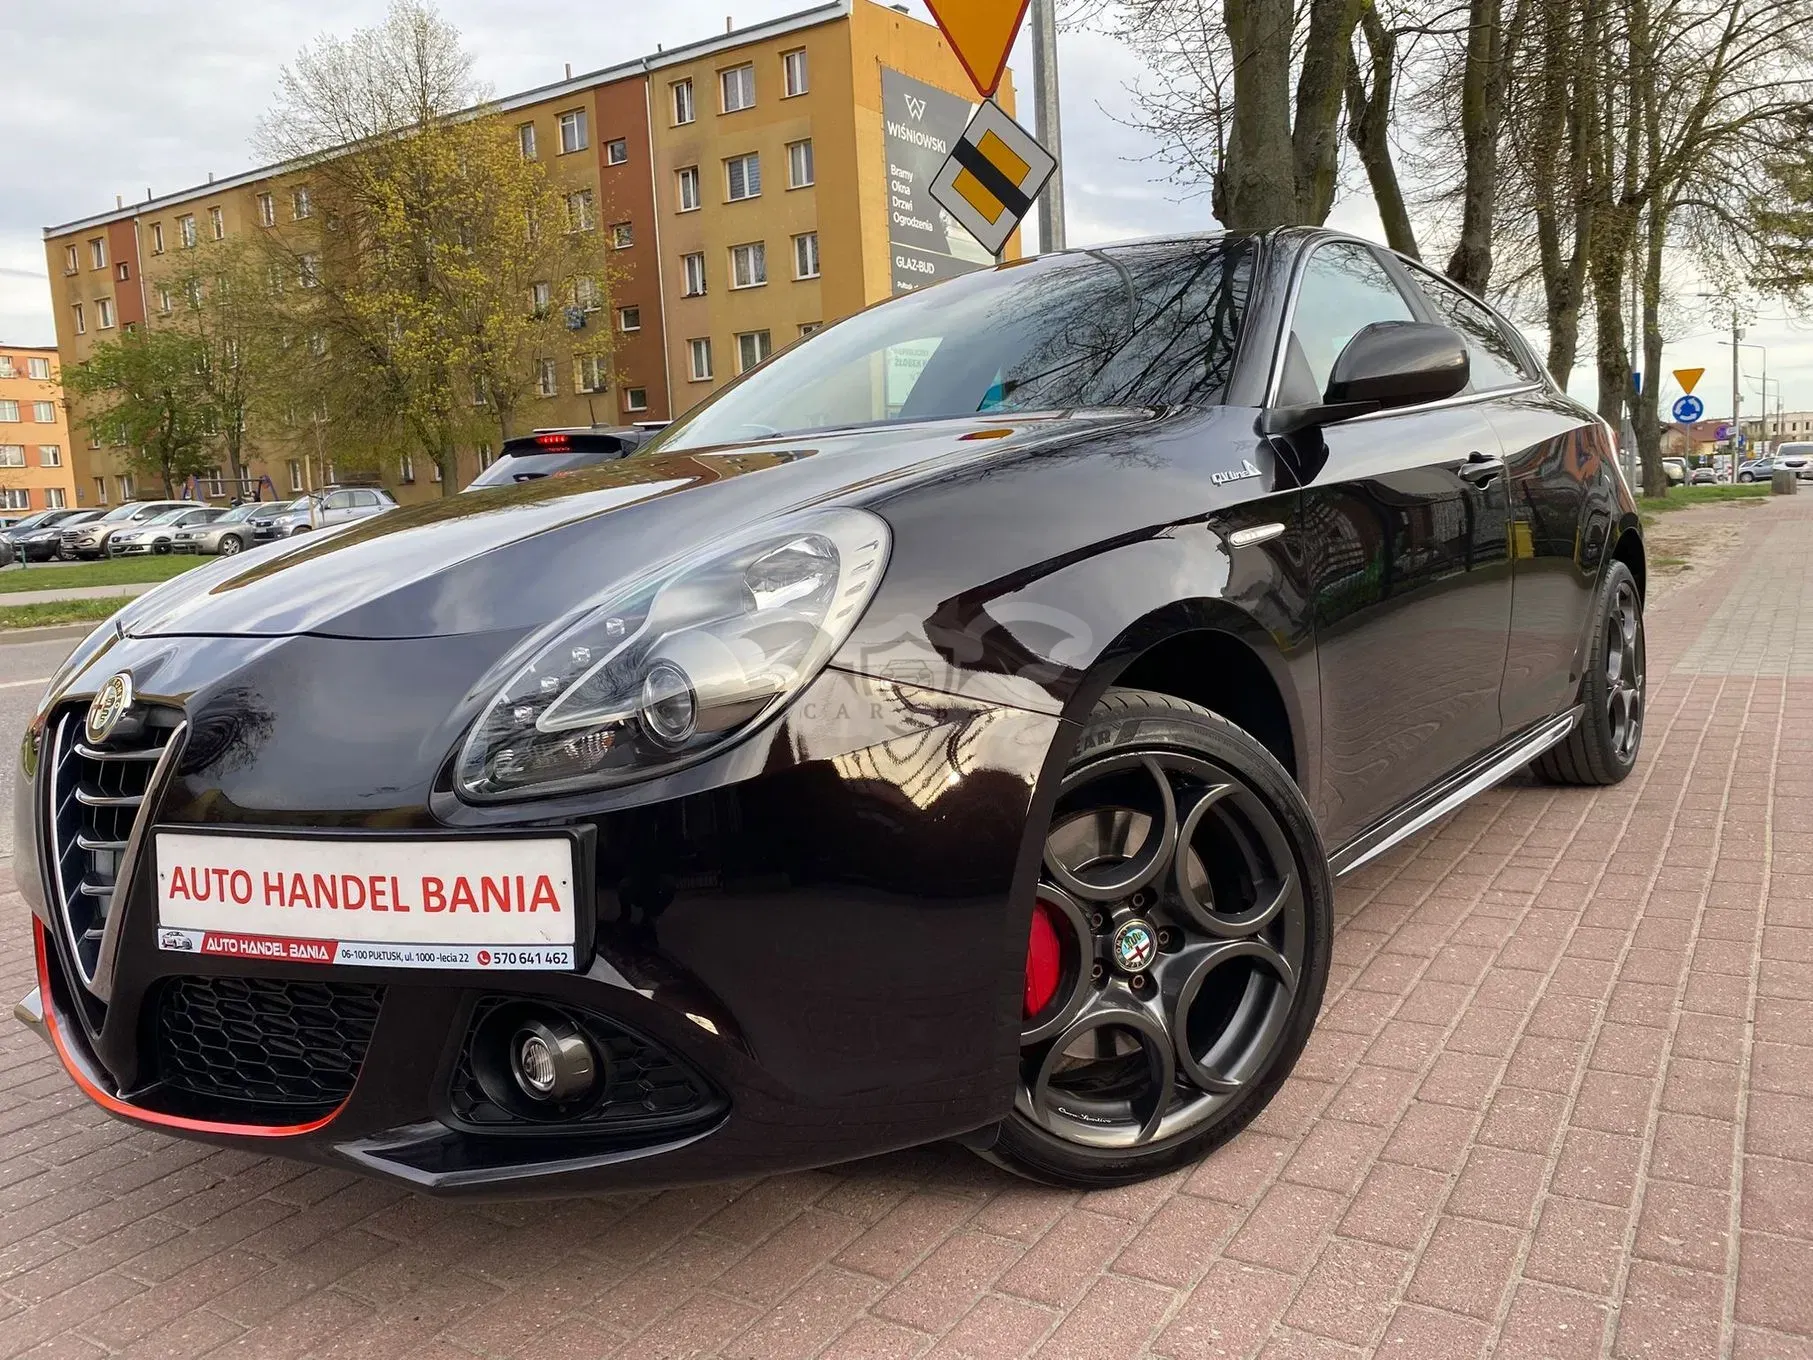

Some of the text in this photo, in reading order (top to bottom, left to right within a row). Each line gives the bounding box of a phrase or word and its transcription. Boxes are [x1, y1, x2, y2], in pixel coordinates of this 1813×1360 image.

[887, 120, 946, 154] WIŚNIOWSKI
[890, 164, 914, 183] Bramy
[891, 180, 911, 195] Okna
[892, 196, 913, 212] Drzwi
[893, 212, 934, 232] Ogrodzenia
[895, 255, 935, 275] GLAZ-BUD
[169, 866, 561, 913] AUTO HANDEL BANIA
[206, 937, 330, 960] AUTO HANDEL BANIA
[341, 949, 368, 960] 06-100
[404, 952, 415, 962] ul.
[417, 951, 436, 962] 1000
[459, 953, 469, 963] 22
[493, 952, 569, 965] 570 641 462
